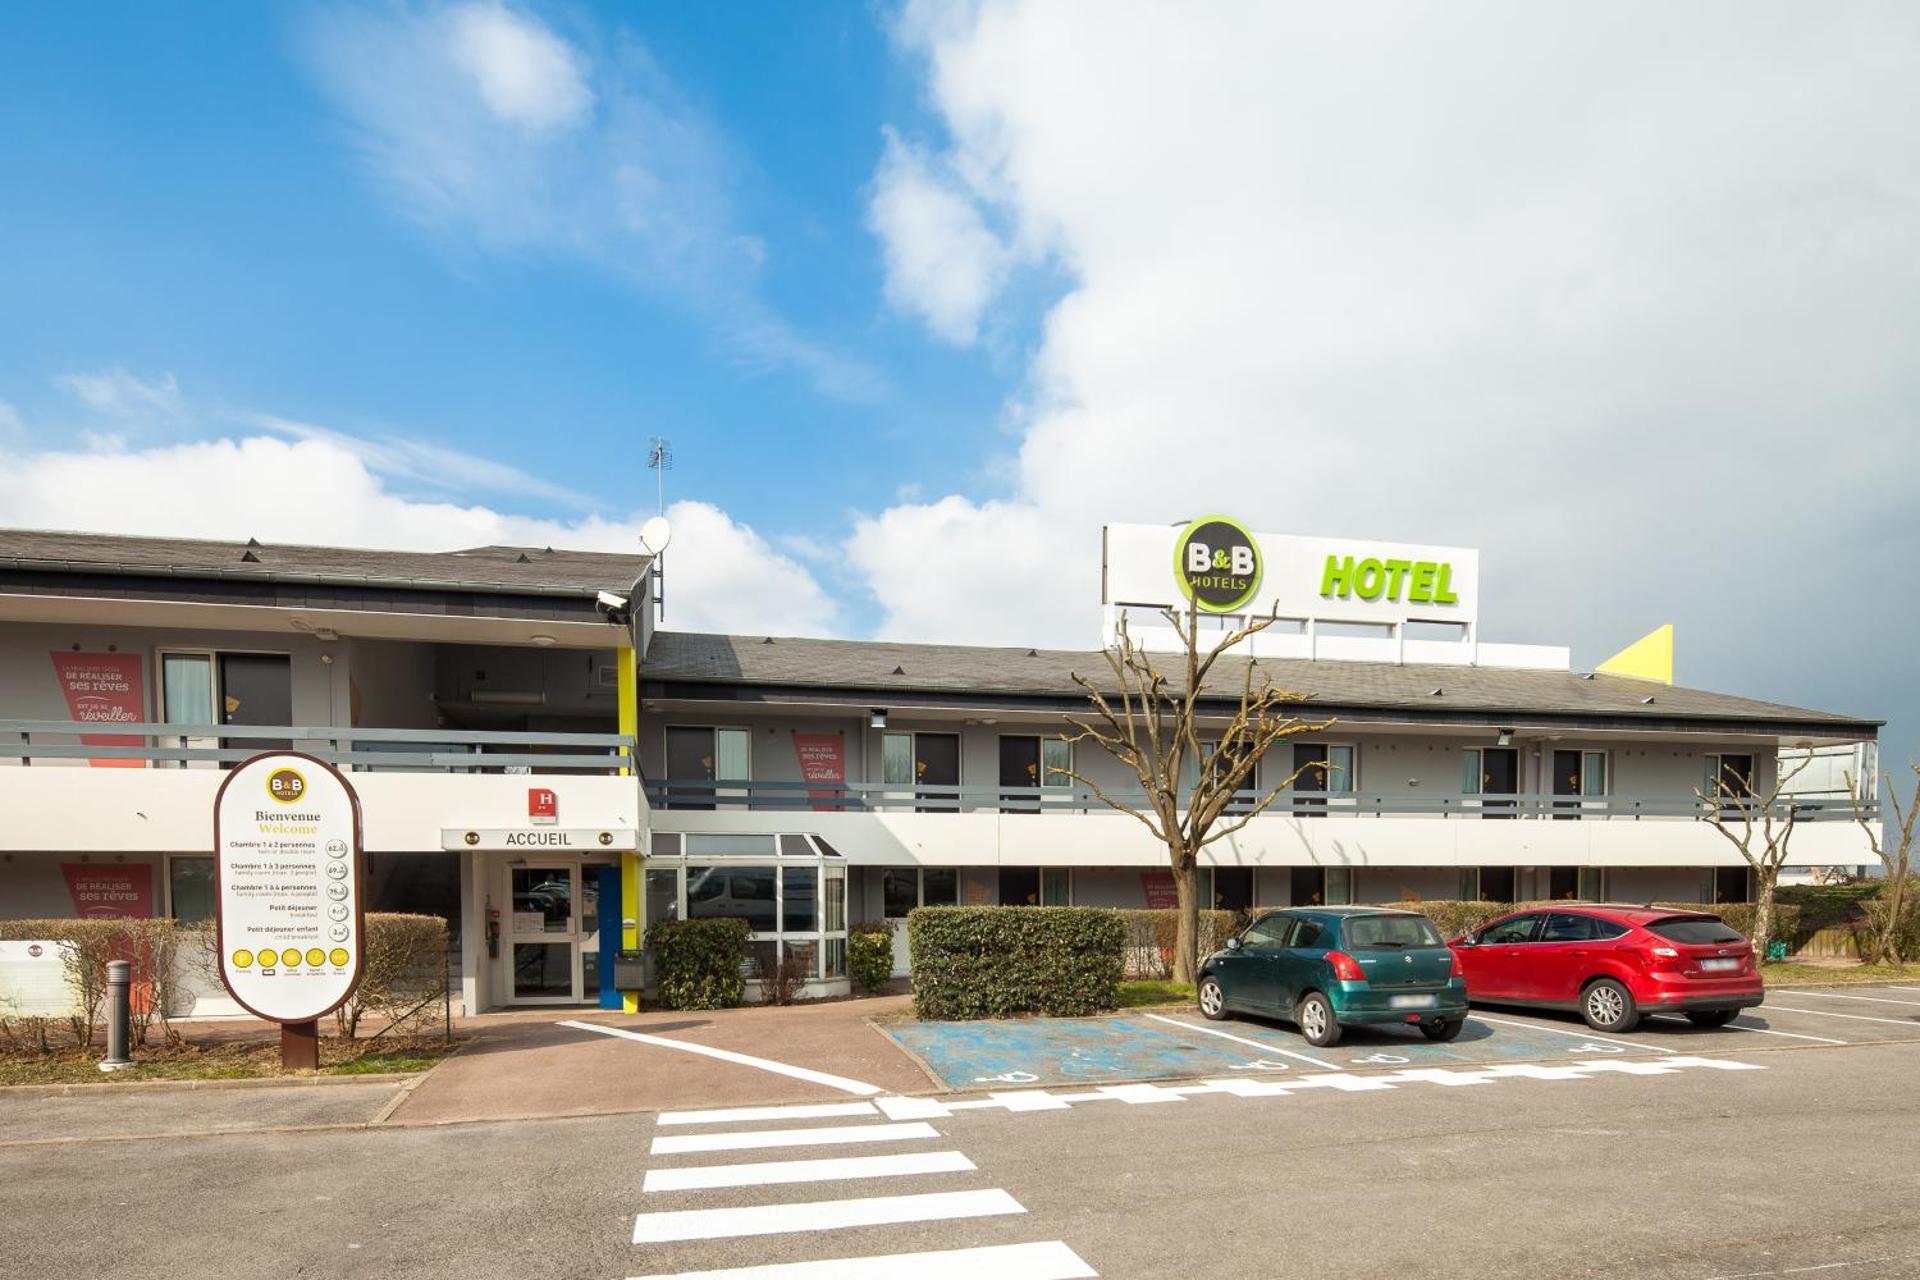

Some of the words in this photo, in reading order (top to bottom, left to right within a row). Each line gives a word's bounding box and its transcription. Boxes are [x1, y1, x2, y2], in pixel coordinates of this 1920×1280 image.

[1188, 542, 1254, 576] B&B
[1190, 575, 1247, 590] HOTELS
[1319, 555, 1458, 604] HOTEL
[66, 671, 78, 680] DE
[272, 779, 302, 791] B&B
[540, 793, 552, 805] H
[256, 811, 321, 822] Bienvenue
[260, 823, 318, 835] Welcome
[507, 833, 571, 846] ACCUEIL
[287, 904, 317, 912] déjeuner
